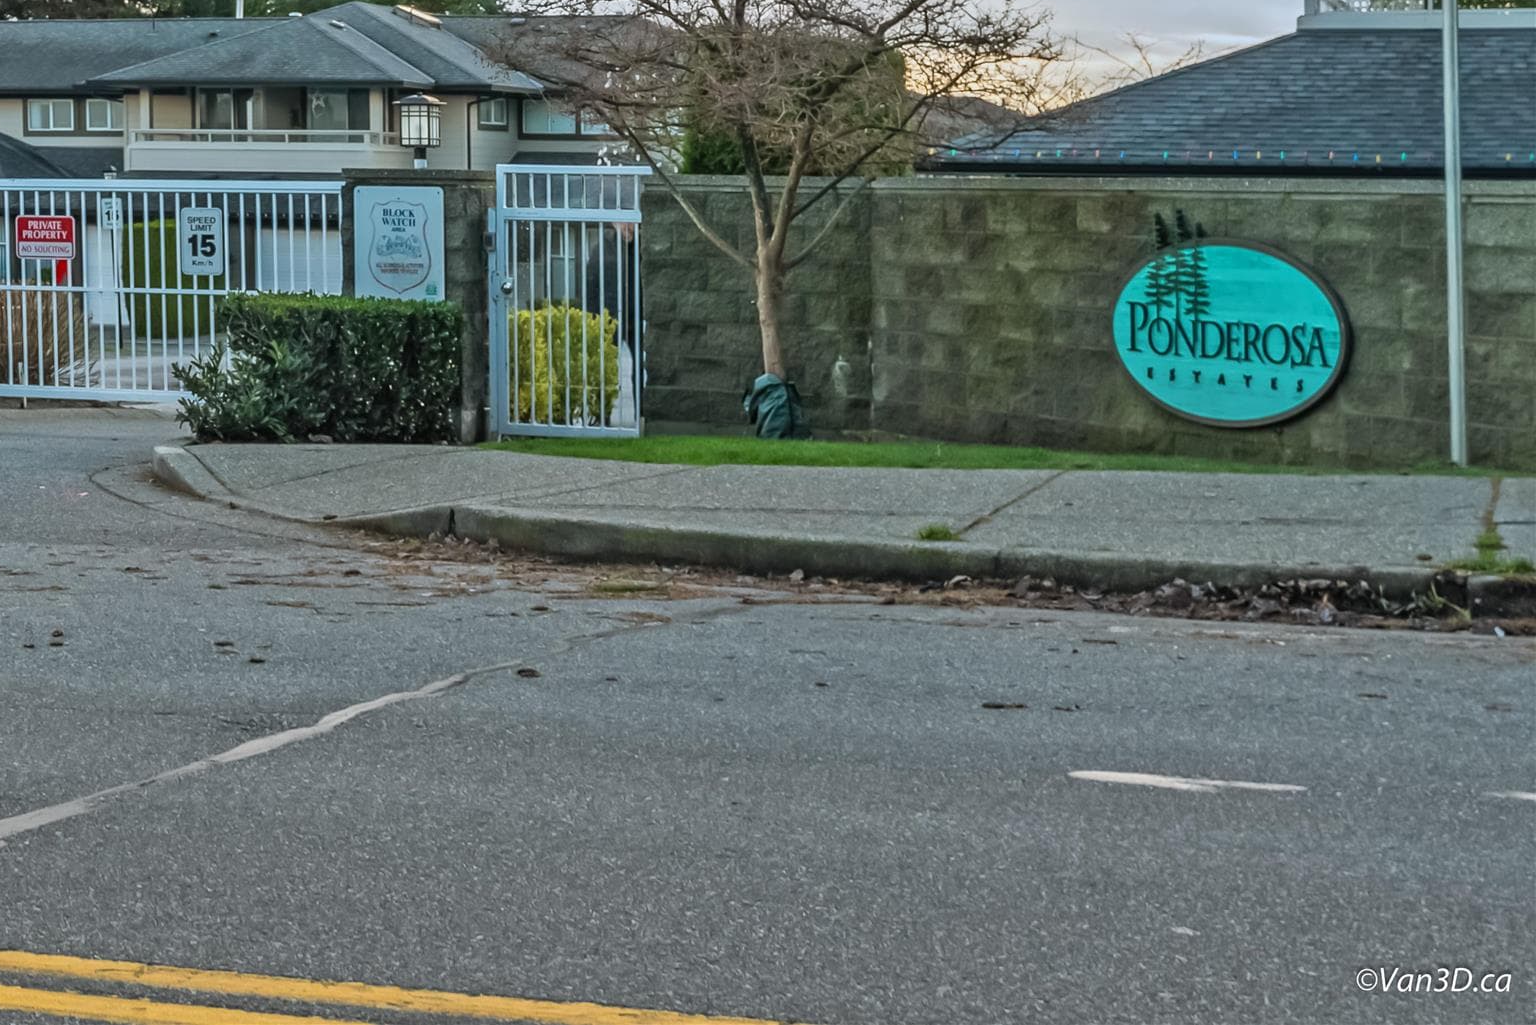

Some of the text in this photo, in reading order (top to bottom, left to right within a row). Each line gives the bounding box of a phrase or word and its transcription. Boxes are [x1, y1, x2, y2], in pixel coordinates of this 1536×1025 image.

[382, 209, 415, 217] BLOCK
[187, 216, 216, 224] SPEED
[382, 217, 416, 227] WATCH
[28, 220, 63, 230] PRIVATE
[190, 224, 213, 232] LIMIT
[22, 230, 68, 239] PROPERTY
[21, 245, 32, 253] NO
[188, 234, 216, 257] 15
[1126, 301, 1332, 368] PONDEROSA
[1147, 367, 1304, 393] ESTATES
